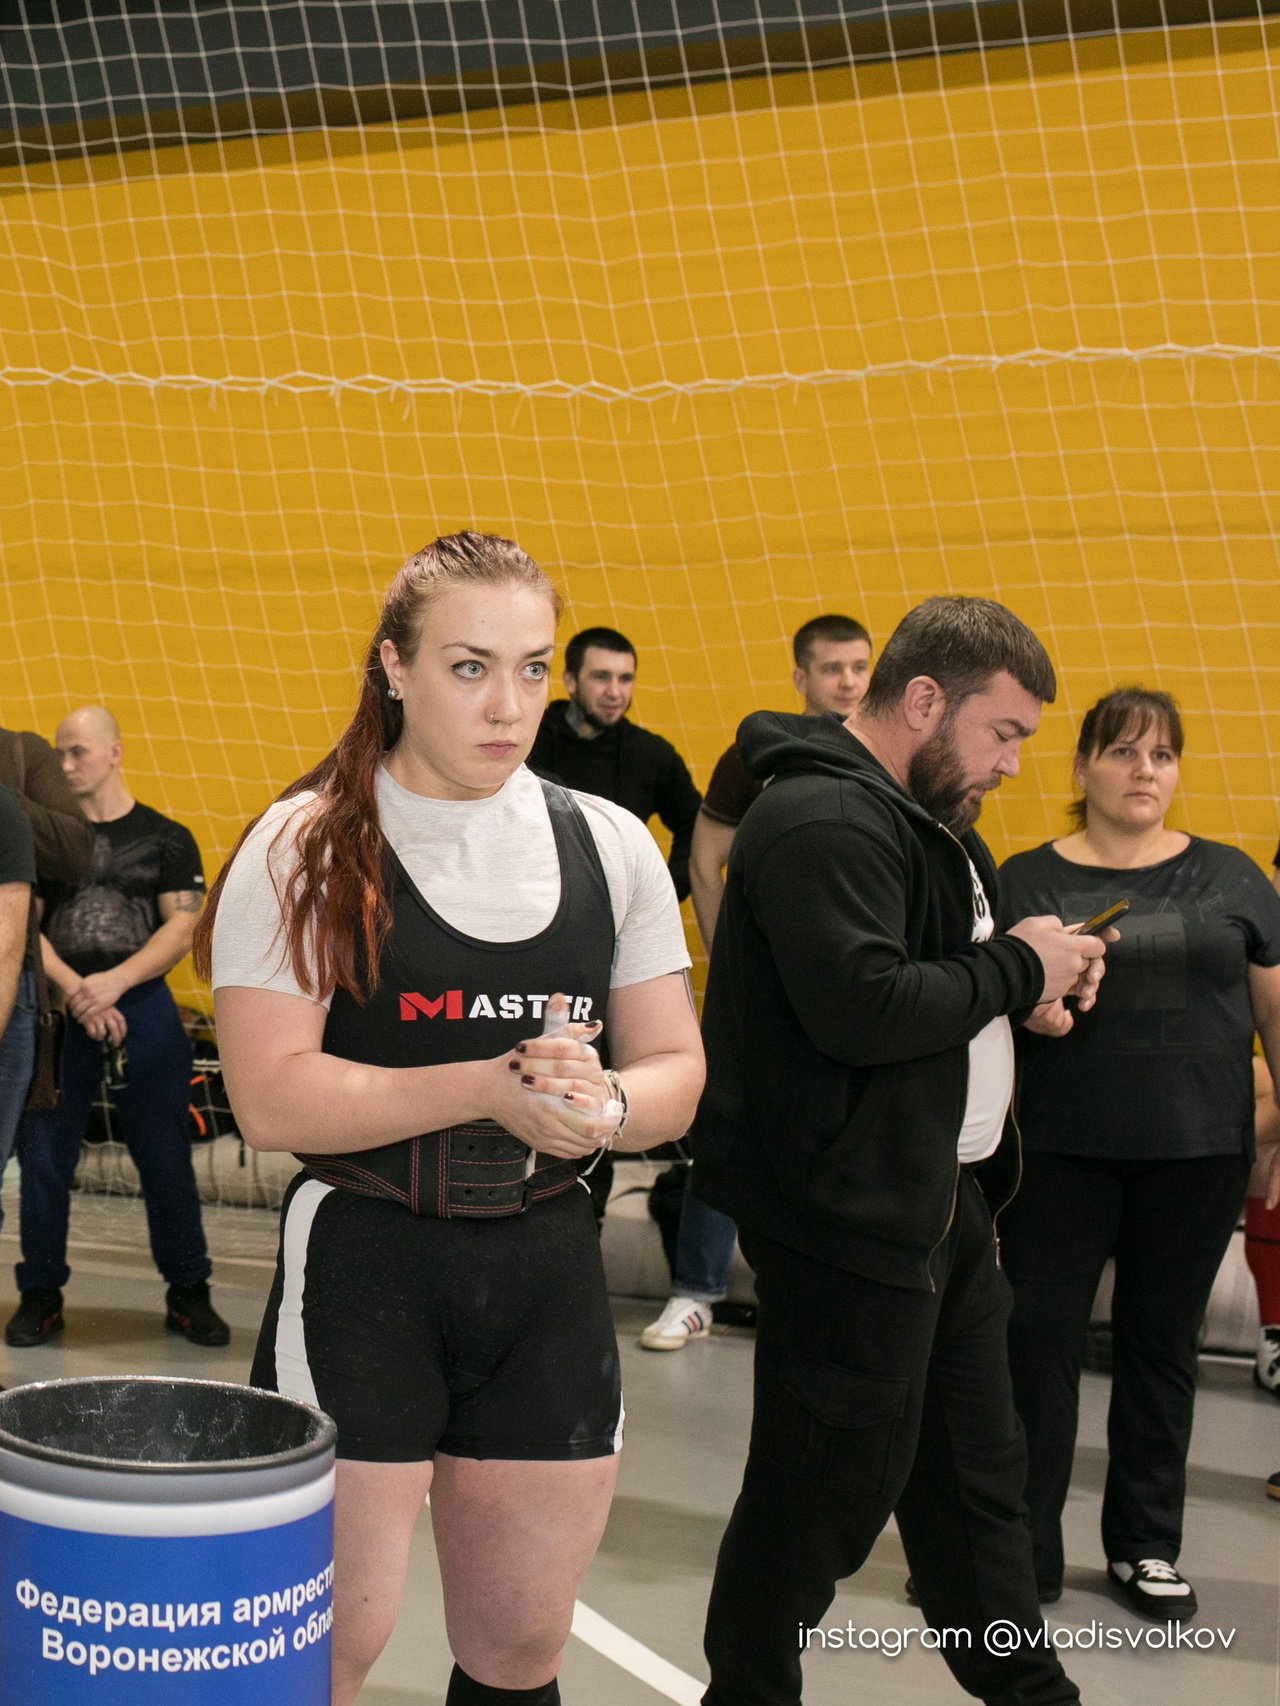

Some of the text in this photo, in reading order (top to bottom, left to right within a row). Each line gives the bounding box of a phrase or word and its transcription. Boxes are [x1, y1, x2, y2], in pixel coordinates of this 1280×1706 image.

[400, 990, 593, 1022] MASTR
[16, 1578, 221, 1633] Федерация
[42, 1627, 286, 1676] Воронежской
